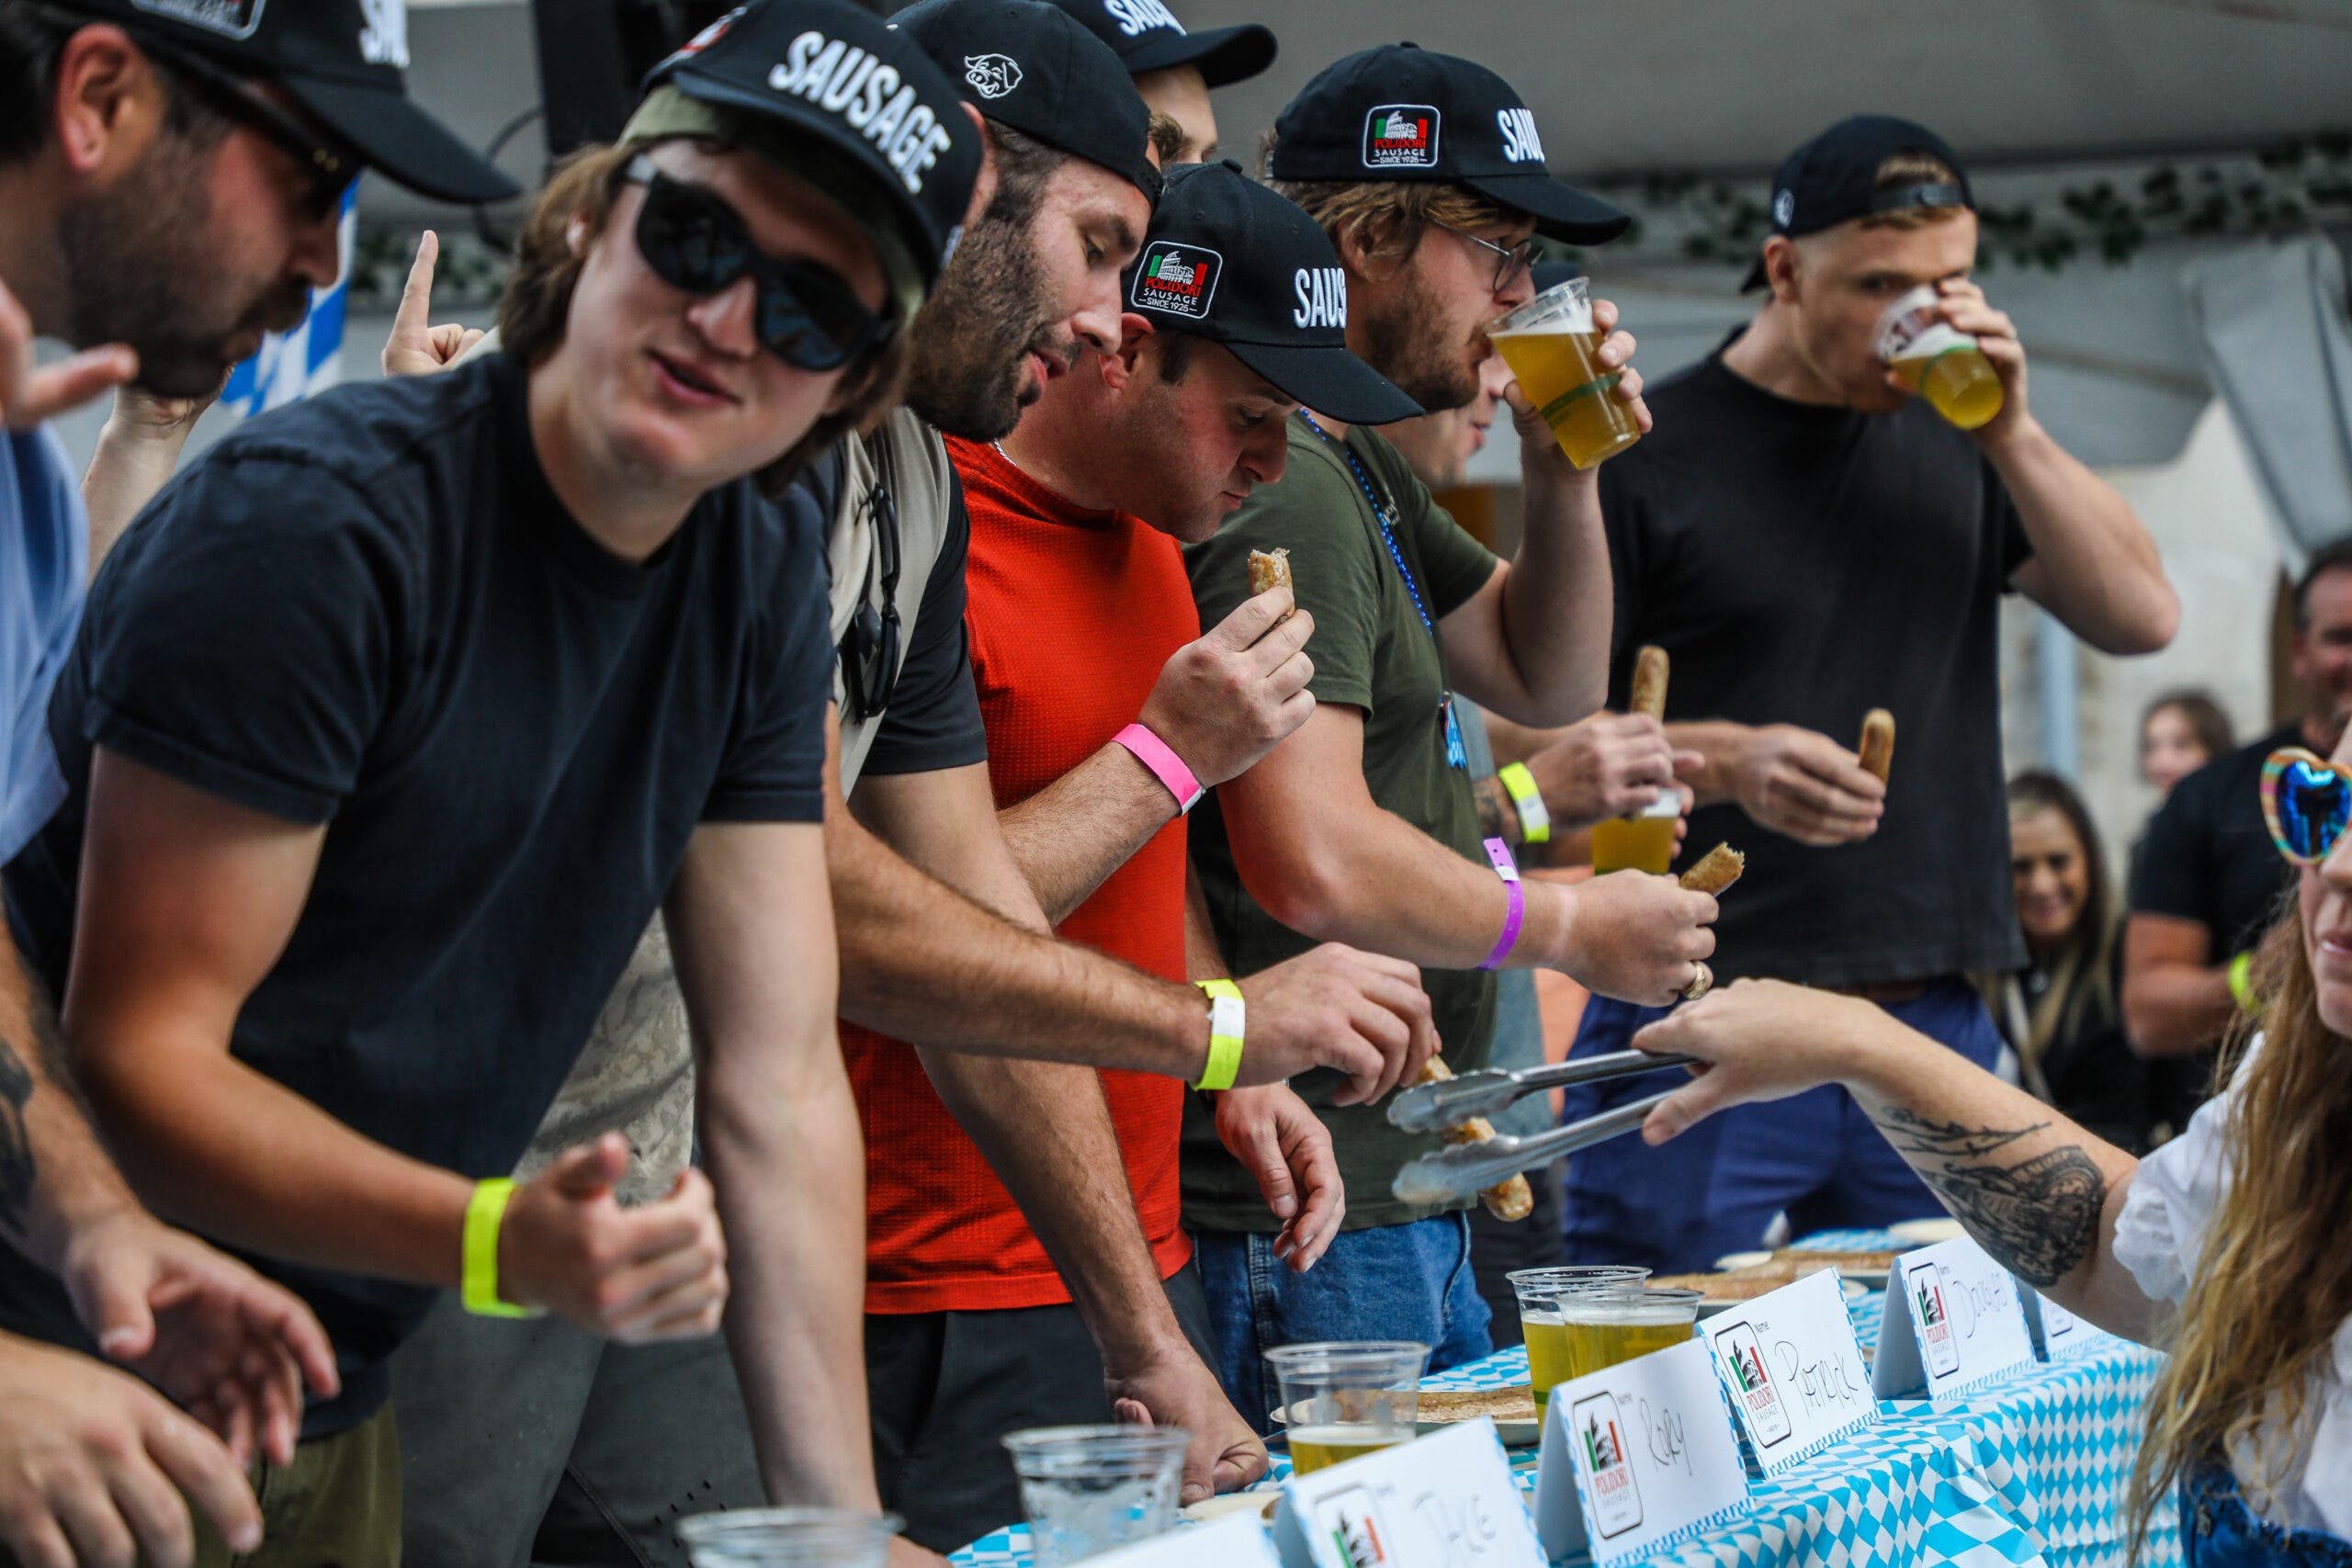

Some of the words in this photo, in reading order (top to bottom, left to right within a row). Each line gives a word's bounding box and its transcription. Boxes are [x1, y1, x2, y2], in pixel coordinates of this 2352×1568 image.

[767, 30, 952, 195] SAUSAGE
[1374, 139, 1426, 149] POLIDORI
[1374, 148, 1426, 157] SAUSAGE
[1379, 156, 1401, 164] SINCE
[1145, 276, 1203, 298] POLIDORI
[1143, 288, 1198, 306] SAUSAGE
[1147, 297, 1170, 310] SINCE
[1170, 301, 1189, 312] 1925
[1747, 1384, 1776, 1413] POLIDORI
